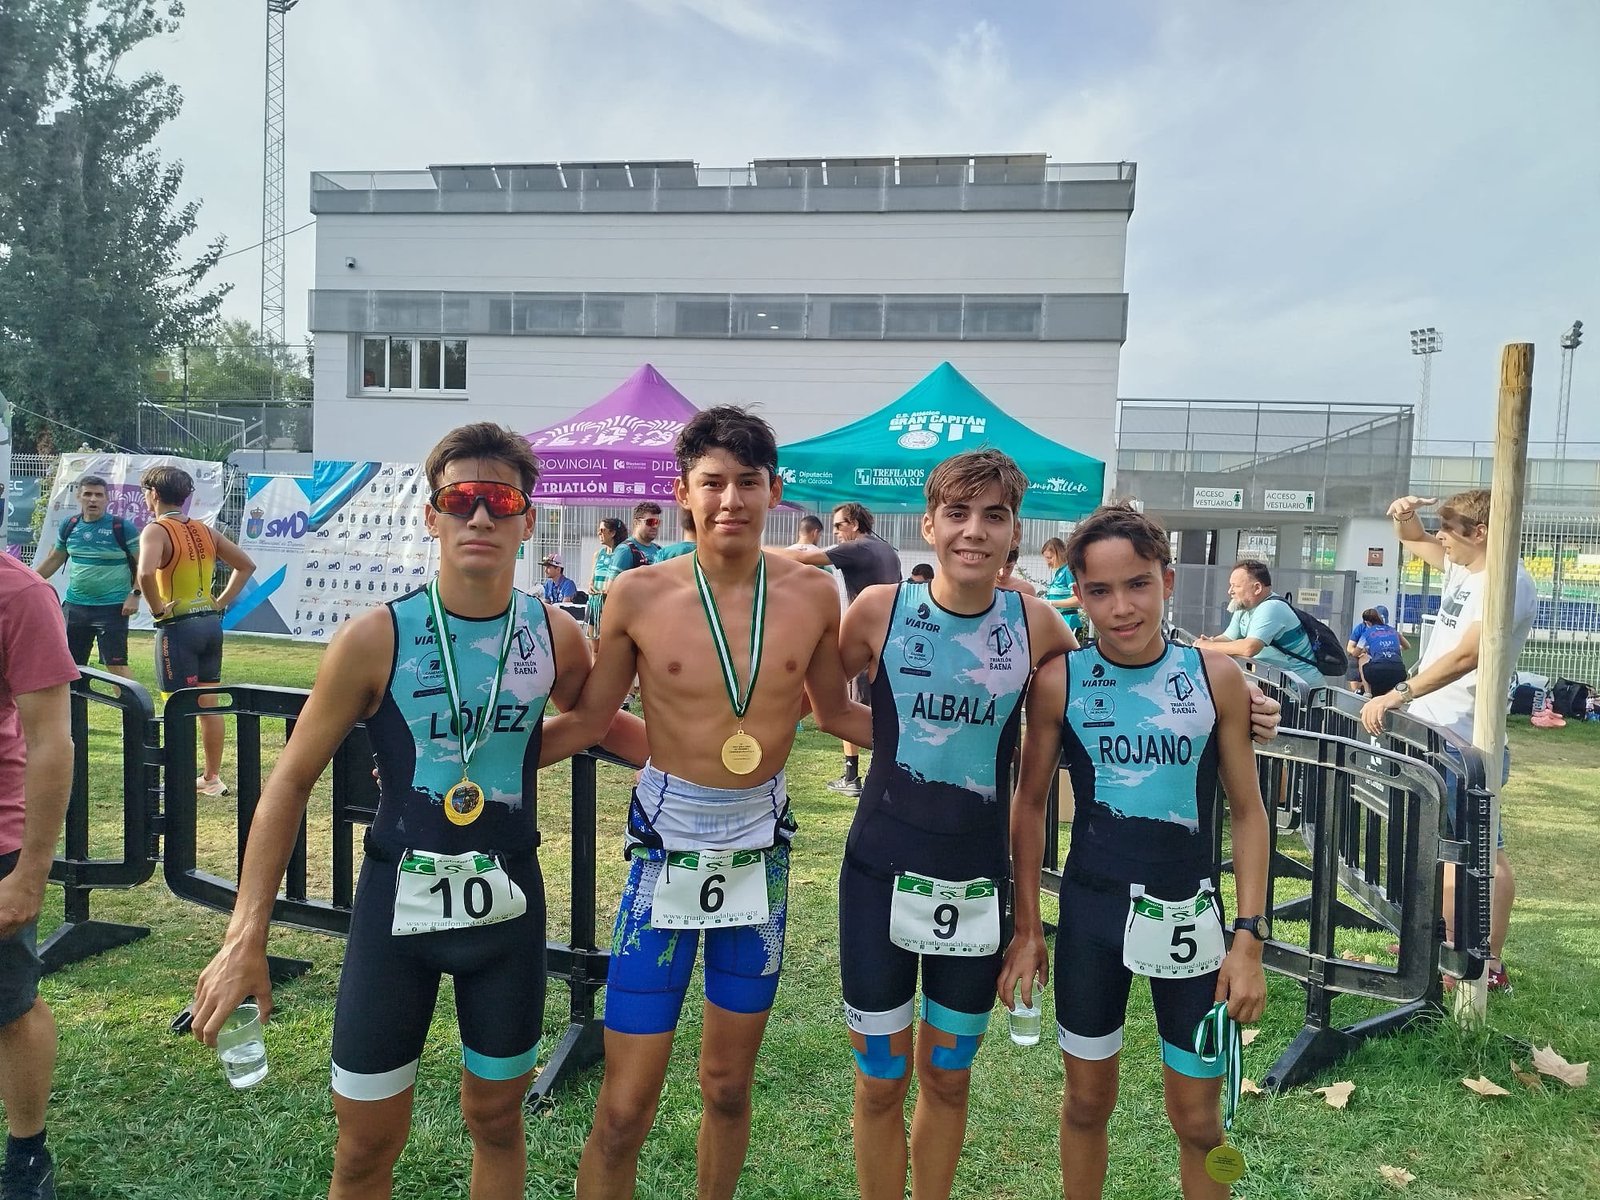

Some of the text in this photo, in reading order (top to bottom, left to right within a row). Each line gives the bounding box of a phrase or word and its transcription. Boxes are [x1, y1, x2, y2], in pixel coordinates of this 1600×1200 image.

[889, 414, 986, 426] GRAN CAPITÁN
[538, 458, 608, 470] ROVINCIAL
[799, 470, 833, 480] Diputación
[872, 468, 925, 478] TREFILADOS
[542, 480, 608, 494] TRIATLÓN
[872, 477, 924, 487] URBANO, S.L.
[1196, 490, 1224, 498] ACCESO
[1266, 492, 1296, 500] ACCESO
[1266, 502, 1306, 510] VESTUARIO
[905, 617, 941, 634] VIATOR
[414, 634, 457, 646] VIAR
[514, 666, 538, 675] BAENA
[990, 662, 1012, 671] BAENA
[1082, 680, 1117, 688] VIATOR
[911, 692, 998, 727] ALBALÁ
[1172, 707, 1198, 715] BAENA
[1098, 734, 1192, 766] ROJANO
[429, 876, 494, 920] 10
[700, 874, 726, 914] 6
[932, 904, 960, 940] 9
[1170, 924, 1198, 964] 5
